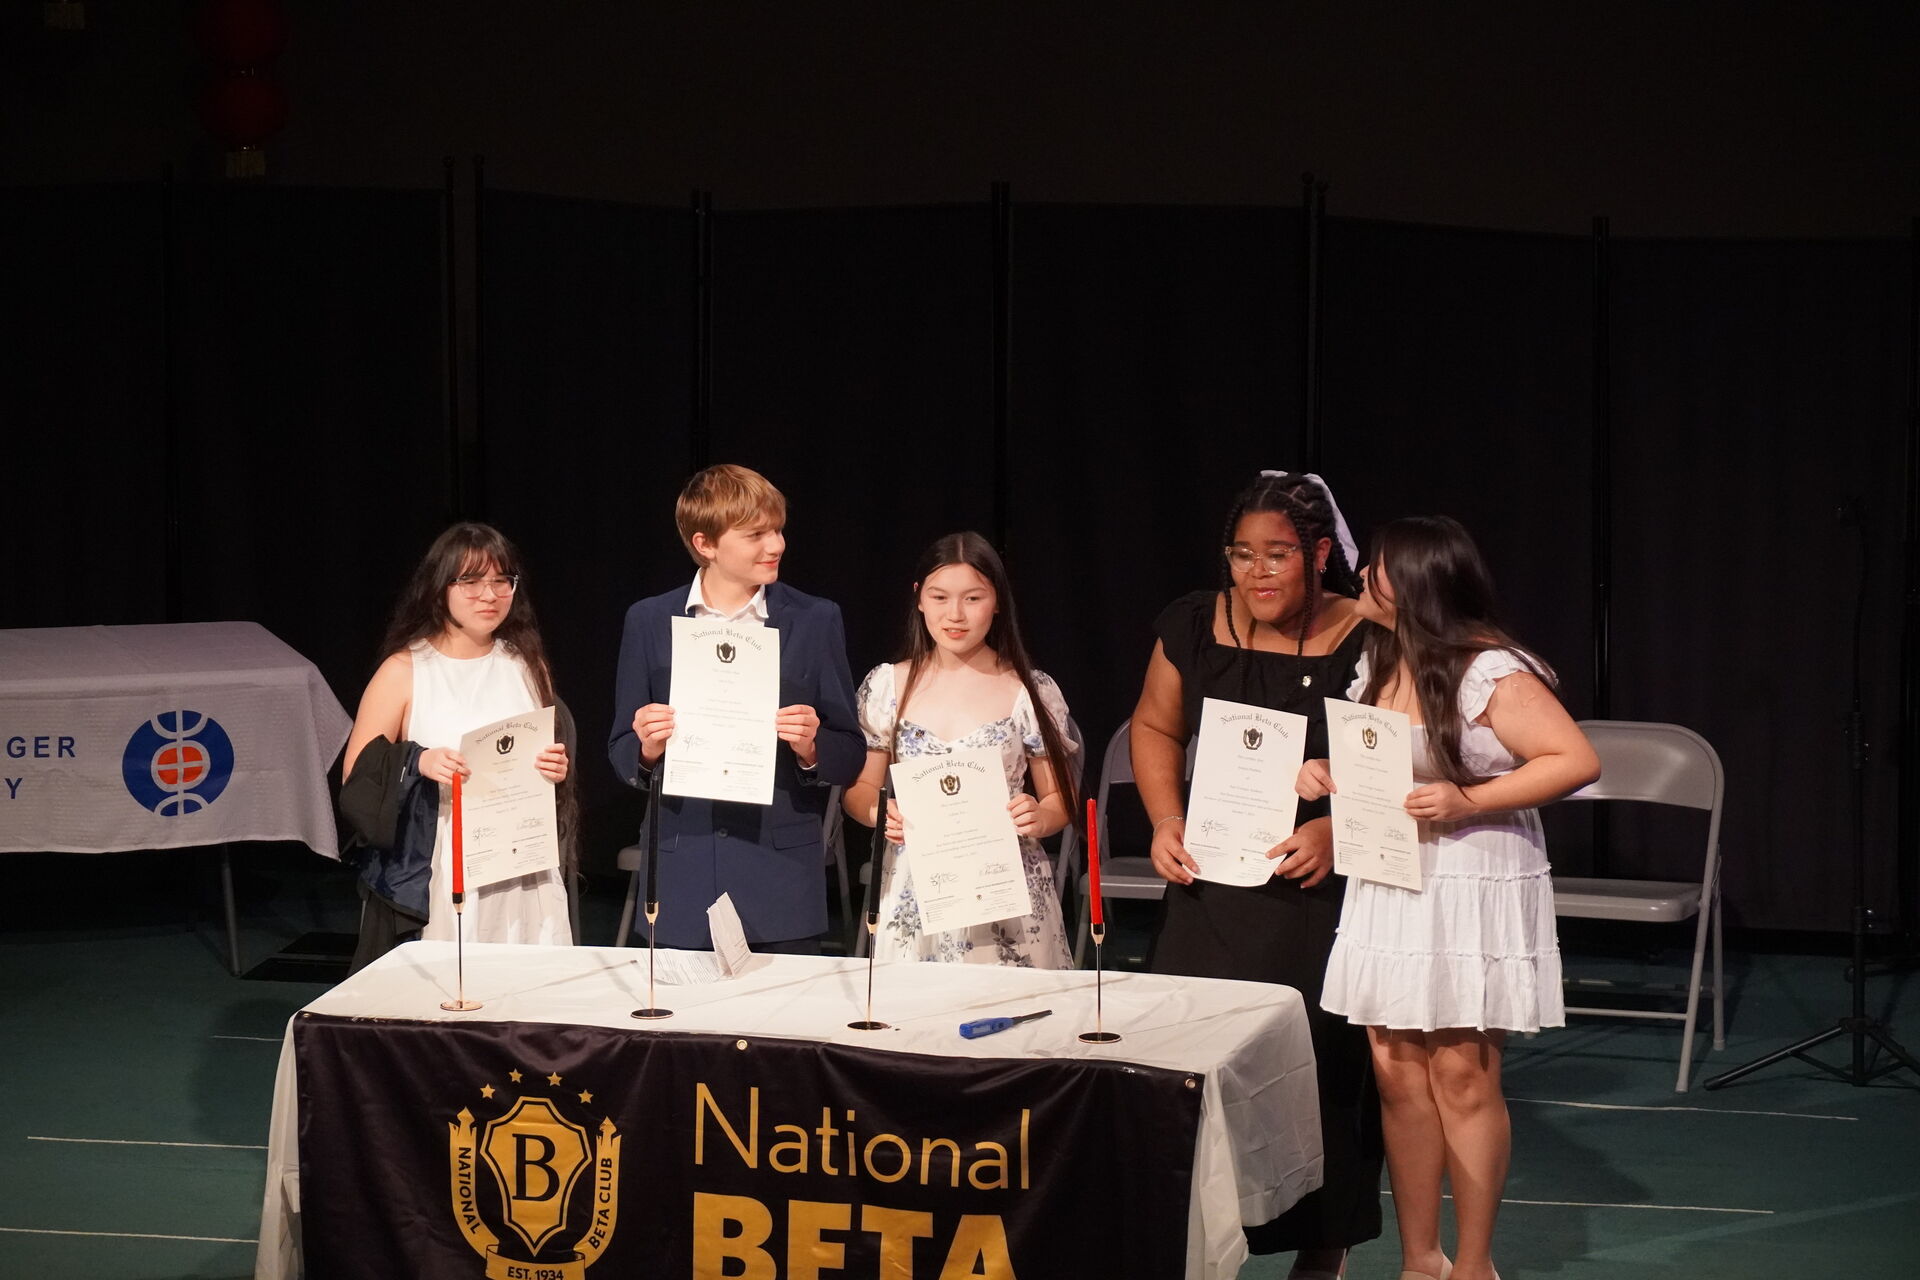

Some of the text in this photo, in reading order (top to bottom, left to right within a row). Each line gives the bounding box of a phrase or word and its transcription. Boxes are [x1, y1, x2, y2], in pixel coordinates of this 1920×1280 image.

[691, 628, 723, 640] National
[1220, 713, 1253, 725] National
[912, 760, 986, 782] National Beta Club
[511, 1133, 560, 1202] B
[695, 1082, 1030, 1190] National
[458, 1146, 482, 1235] NATIONAL
[587, 1157, 613, 1250] BETA CLUB
[692, 1191, 1017, 1280] BETA
[507, 1266, 564, 1280] EST. 1934
